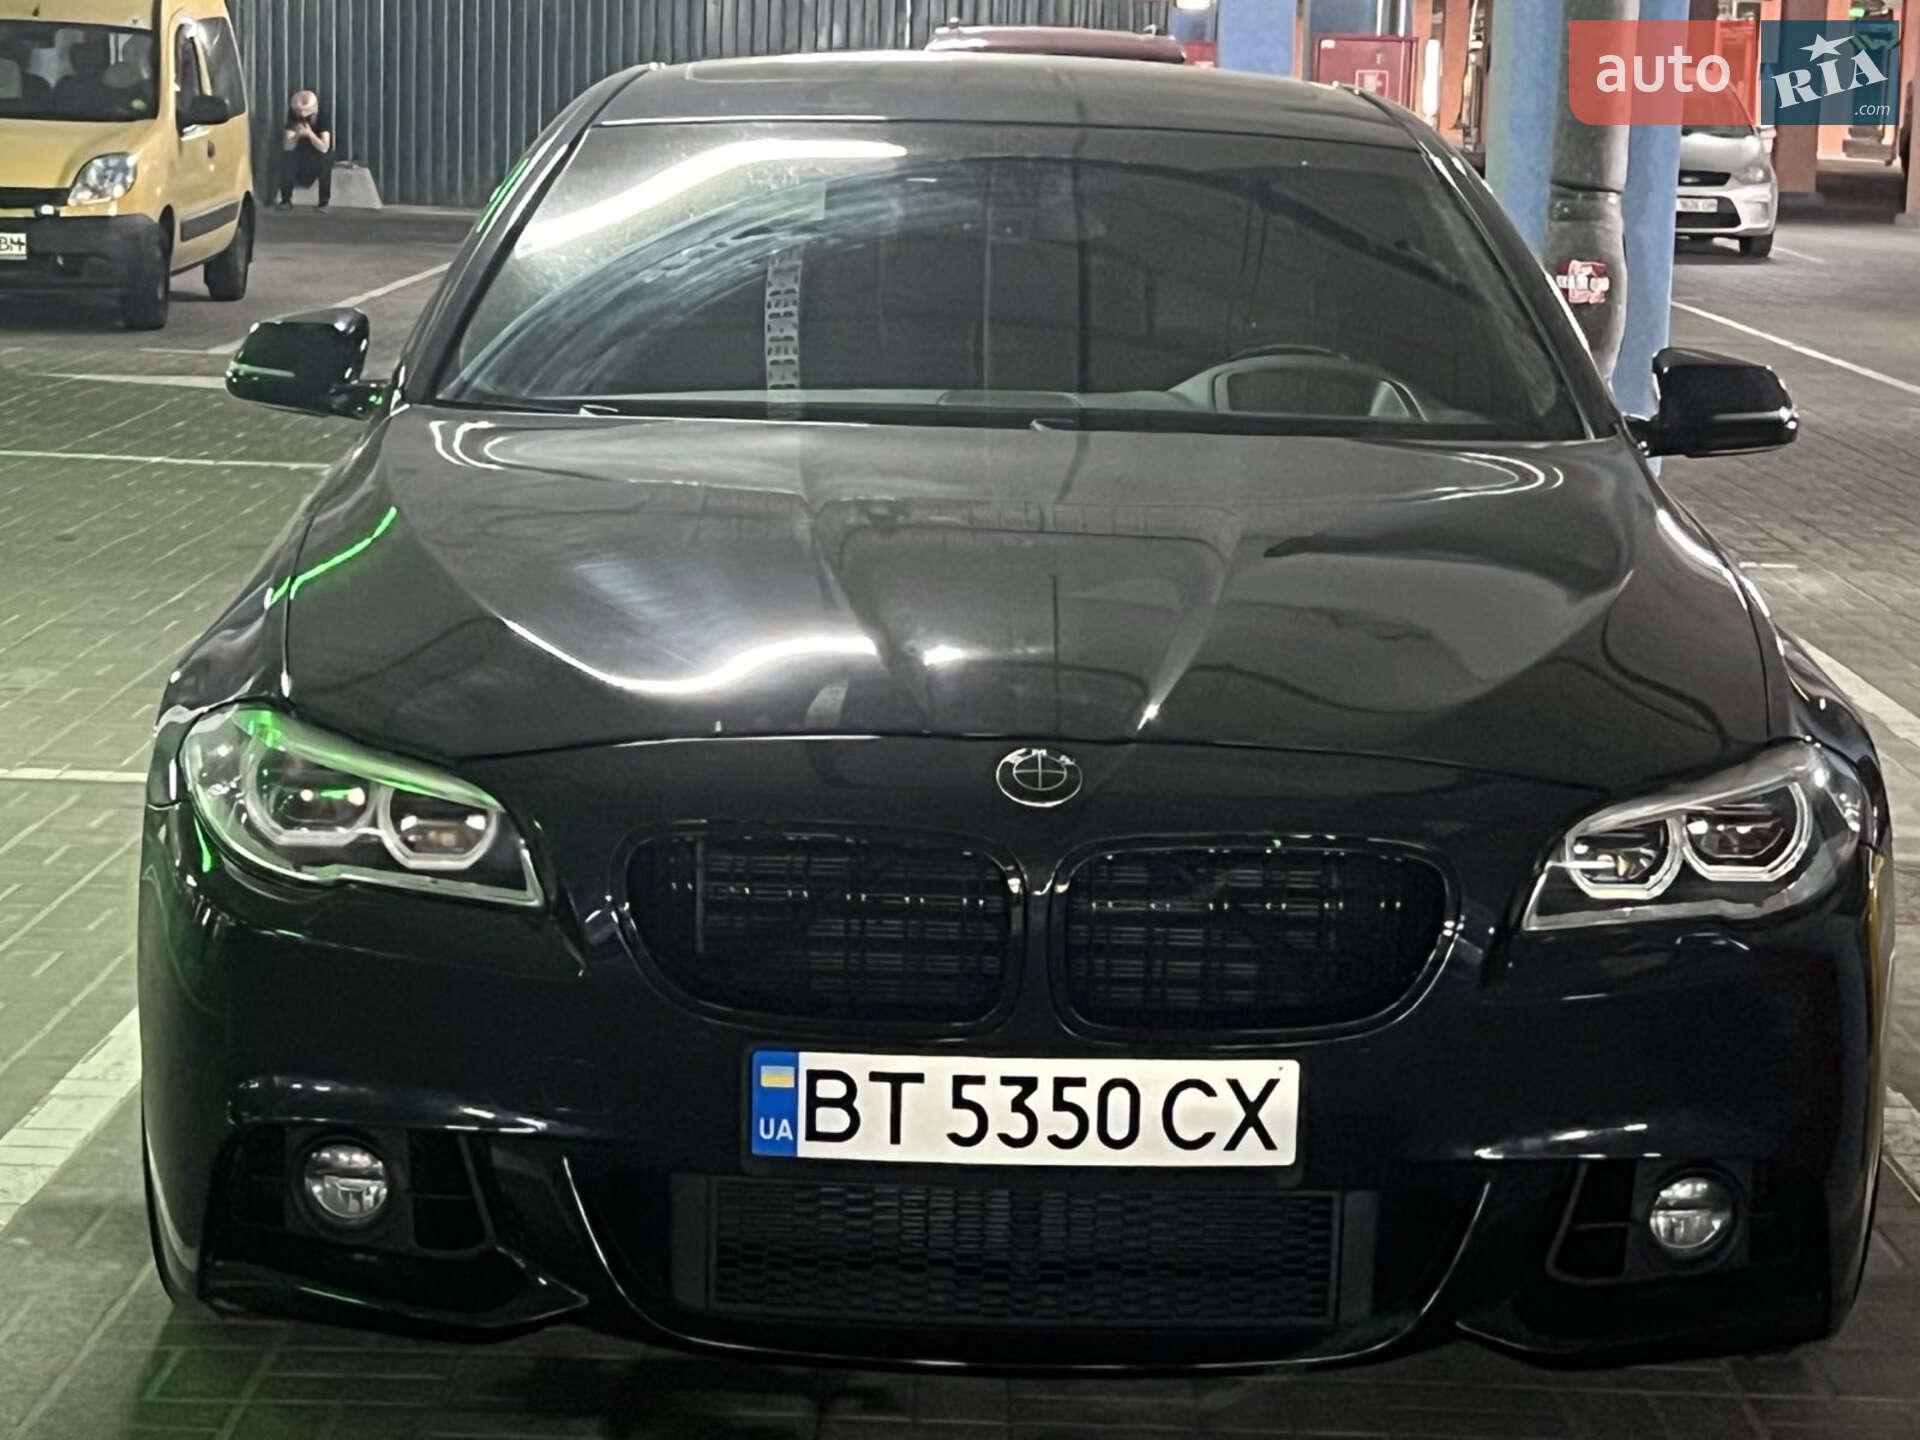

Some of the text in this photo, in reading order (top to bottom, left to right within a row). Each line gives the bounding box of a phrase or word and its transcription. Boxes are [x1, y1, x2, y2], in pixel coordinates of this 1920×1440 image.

[759, 1118, 793, 1140] UA
[805, 1069, 1281, 1151] BT 5350 CX
